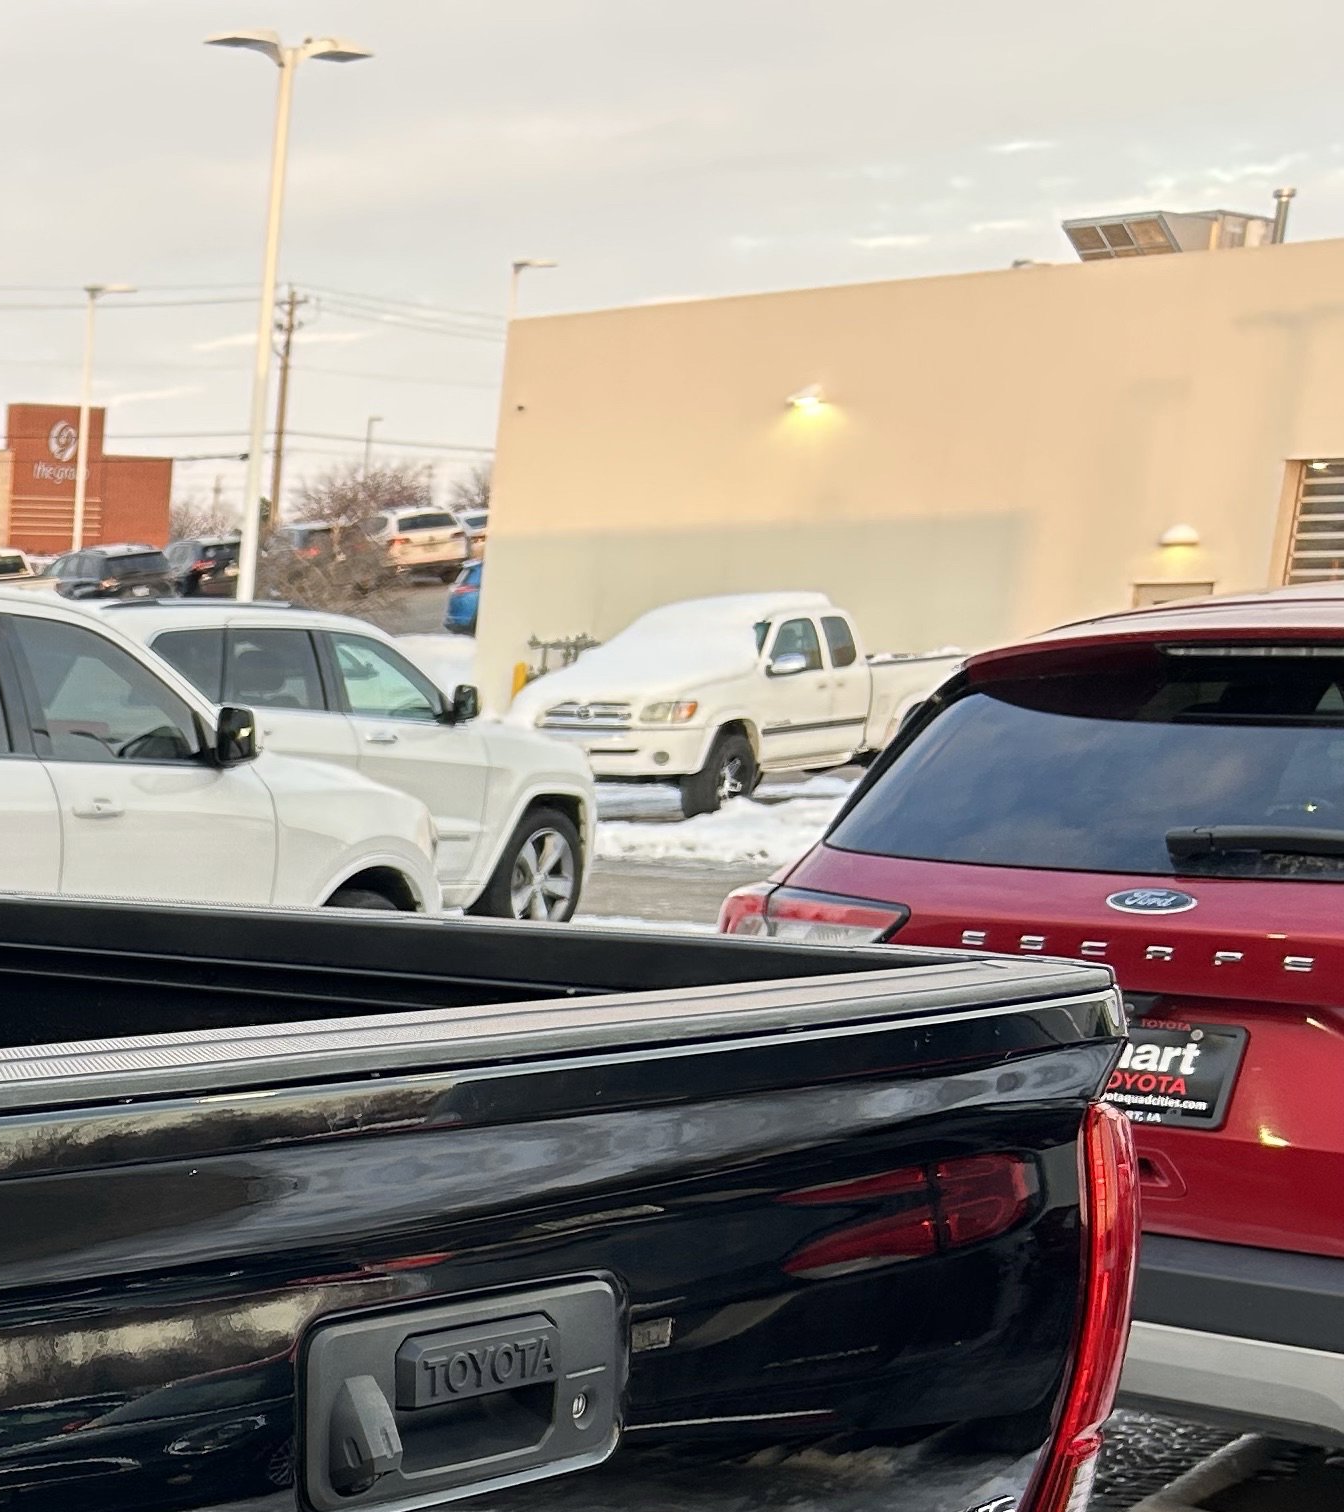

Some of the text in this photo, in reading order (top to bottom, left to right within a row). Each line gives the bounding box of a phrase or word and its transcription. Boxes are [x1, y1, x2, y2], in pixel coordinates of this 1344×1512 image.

[962, 929, 1315, 972] ESCAPE
[1141, 1018, 1192, 1032] TOYOTA
[1118, 1042, 1201, 1075] art
[1108, 1071, 1187, 1095] OYOTA
[424, 1334, 555, 1398] TOYOTA
